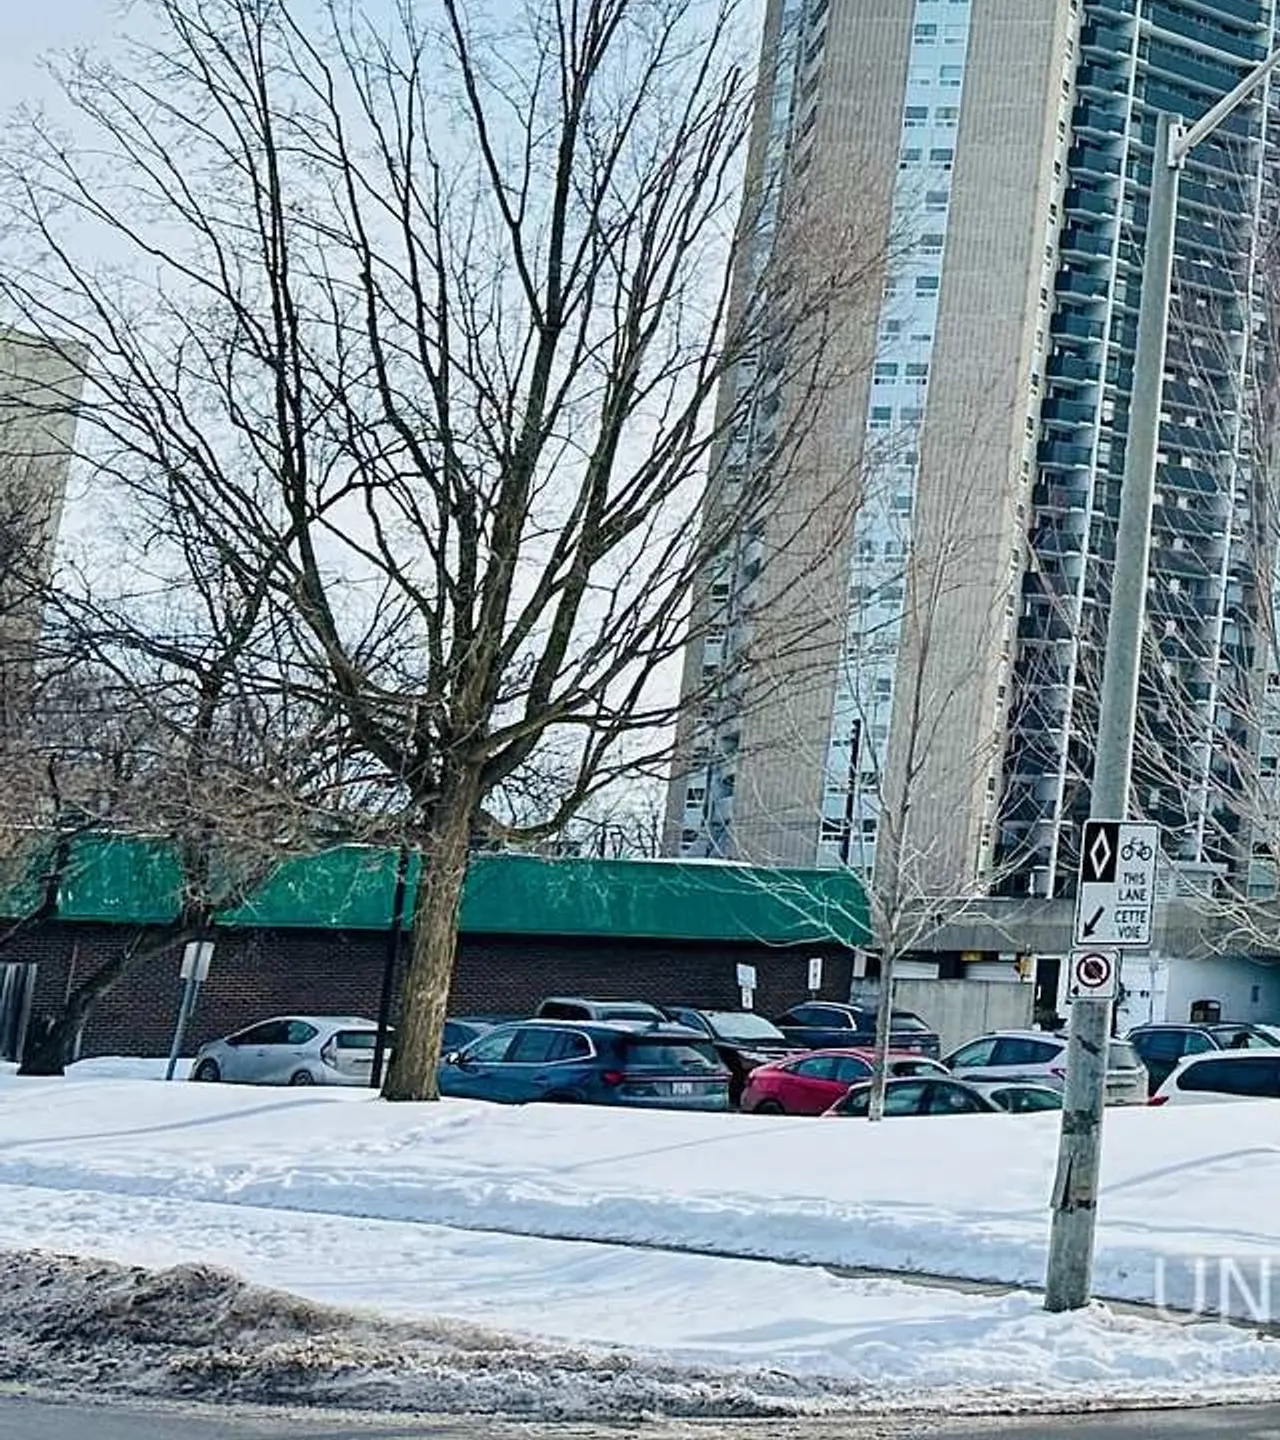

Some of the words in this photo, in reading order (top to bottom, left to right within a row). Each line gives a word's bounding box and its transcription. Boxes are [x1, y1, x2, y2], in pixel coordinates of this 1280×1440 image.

[1123, 872, 1145, 885] THIS
[1118, 887, 1147, 901] LANE
[1114, 909, 1147, 923] CETTE
[1118, 925, 1142, 939] VOIE
